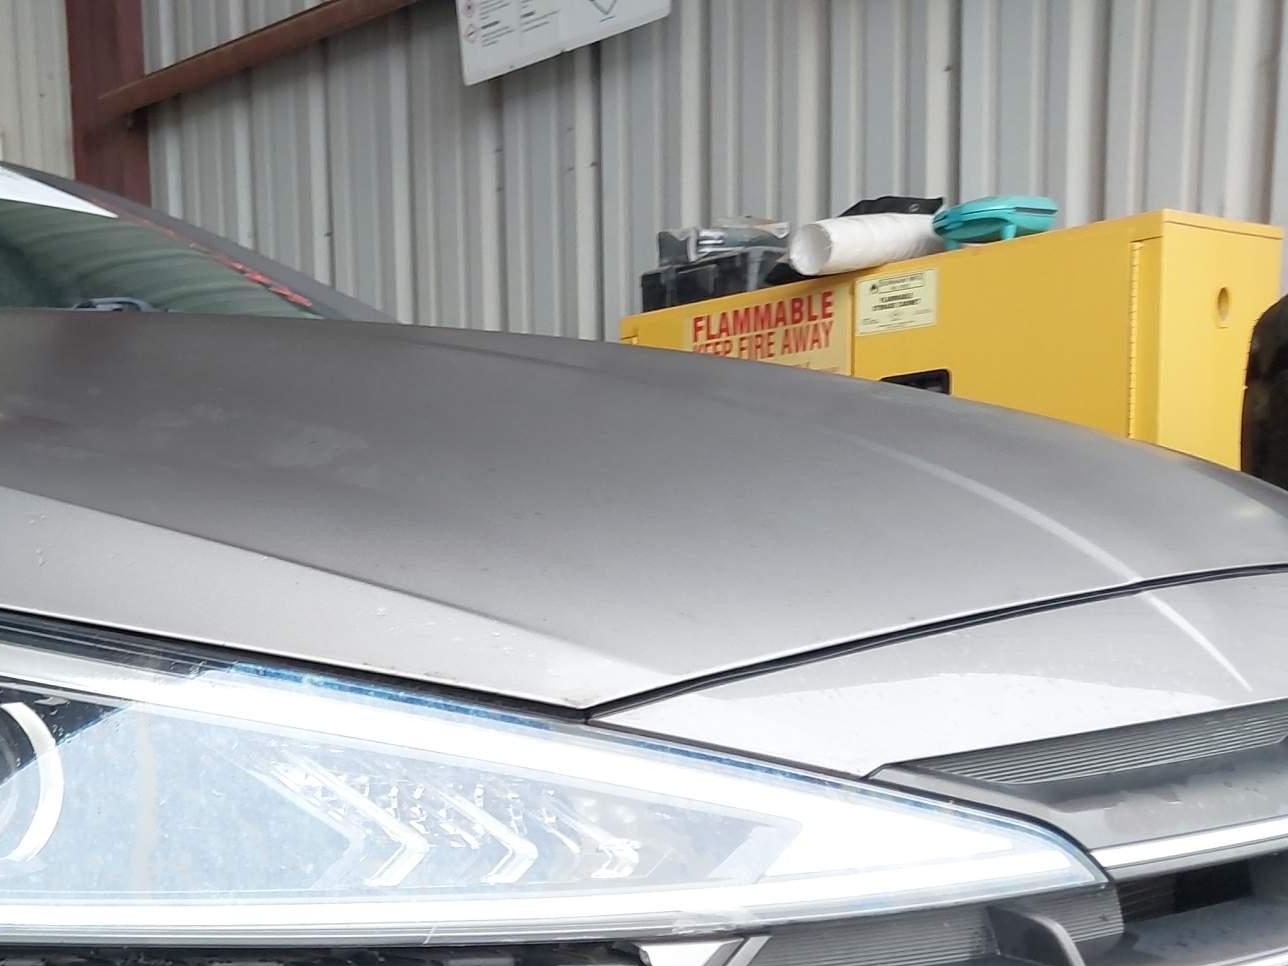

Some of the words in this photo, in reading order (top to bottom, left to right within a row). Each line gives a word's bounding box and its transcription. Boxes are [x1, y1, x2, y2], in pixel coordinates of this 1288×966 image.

[692, 291, 834, 343] FLAMMABLE
[738, 331, 776, 360] FIRE
[781, 320, 834, 355] AWAY
